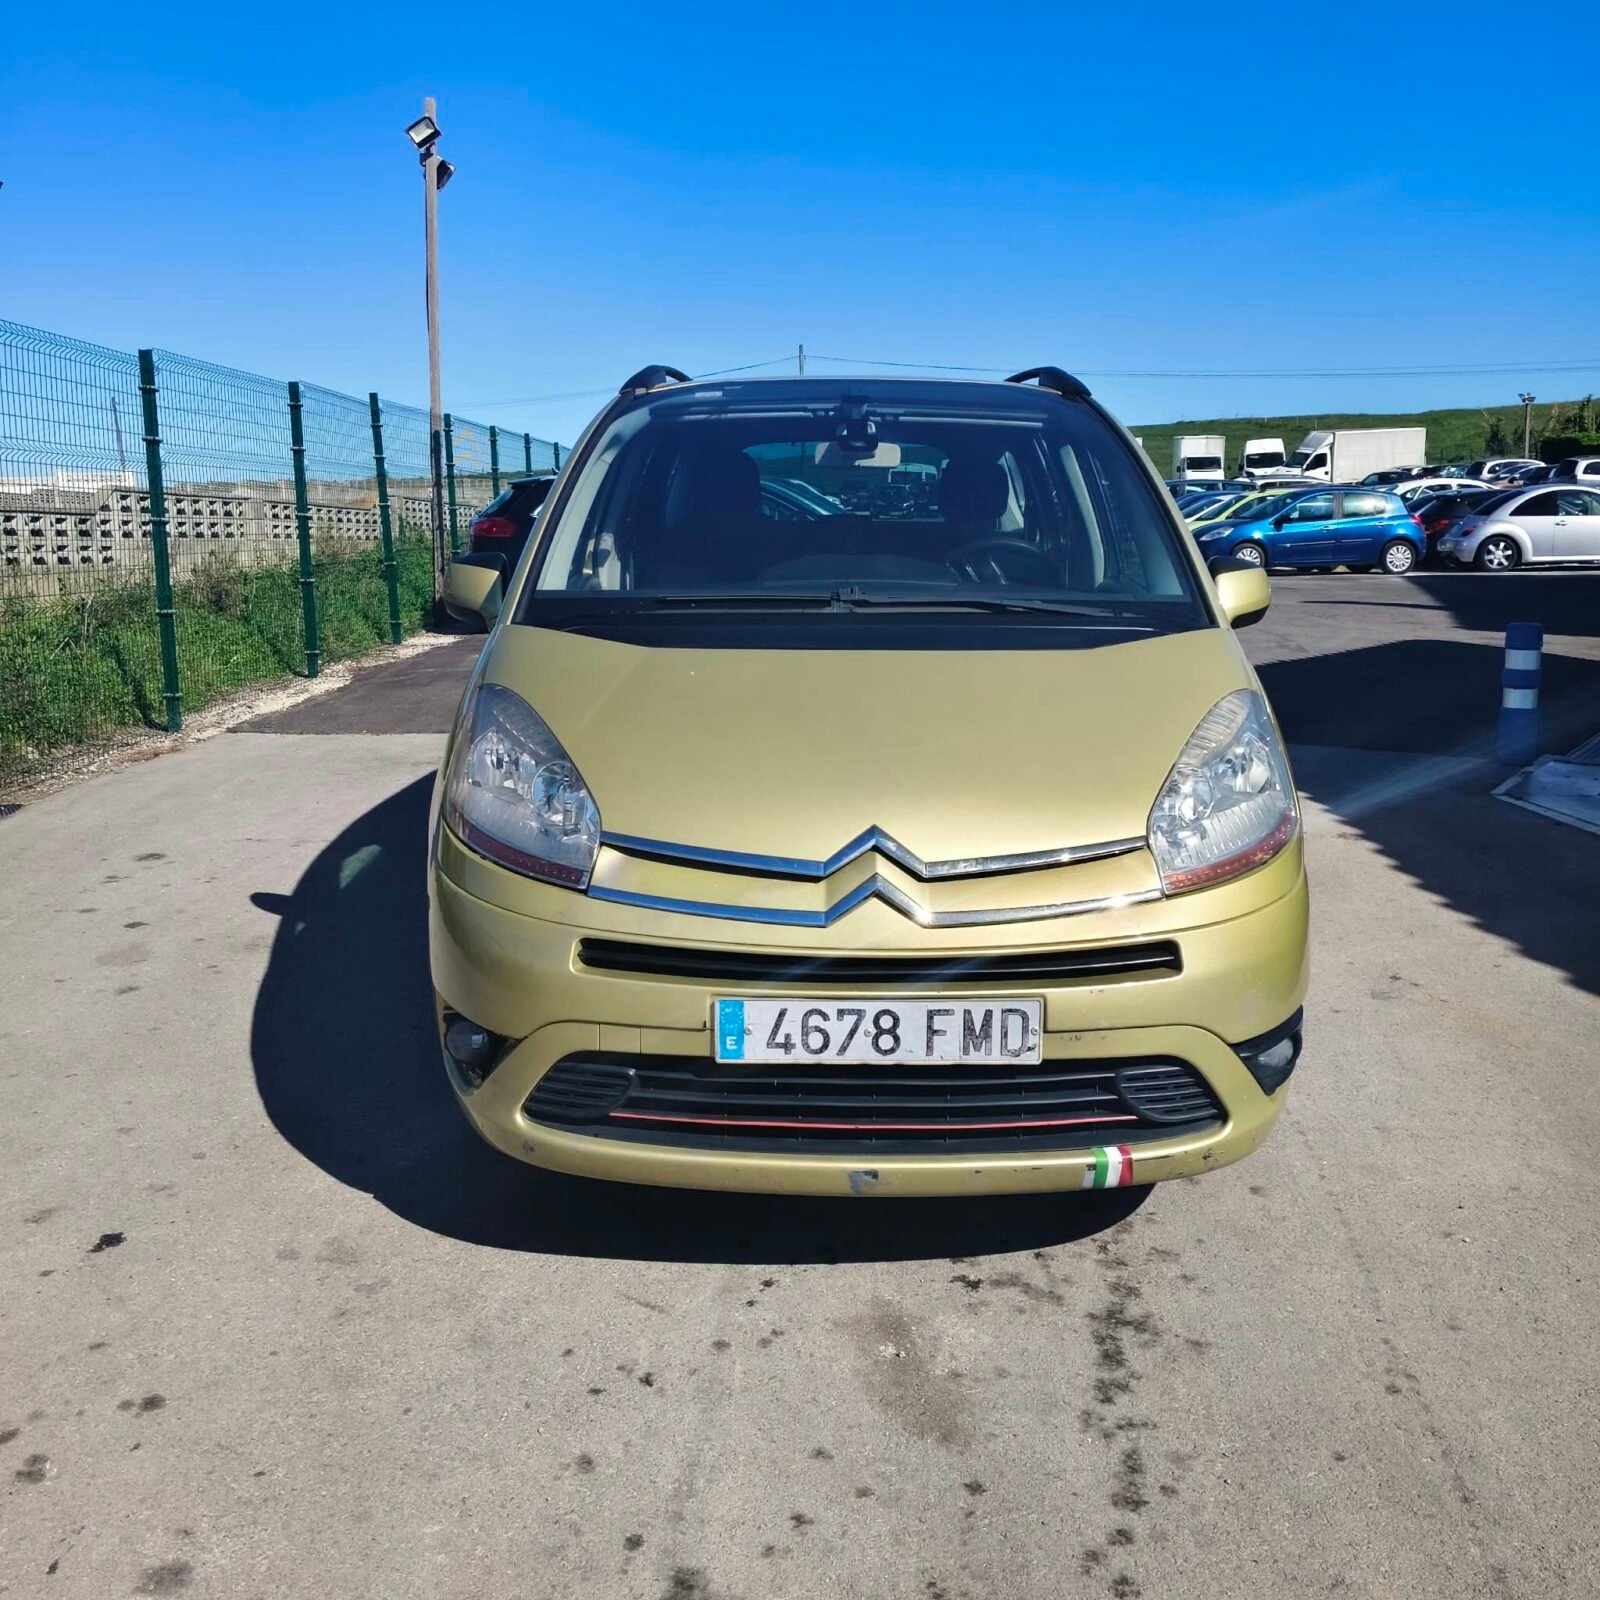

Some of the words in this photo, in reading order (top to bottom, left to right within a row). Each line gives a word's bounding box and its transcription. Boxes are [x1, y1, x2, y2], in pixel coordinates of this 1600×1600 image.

[726, 1037, 737, 1049] E
[766, 1007, 901, 1056] 4678
[925, 1007, 1030, 1057] FMD
